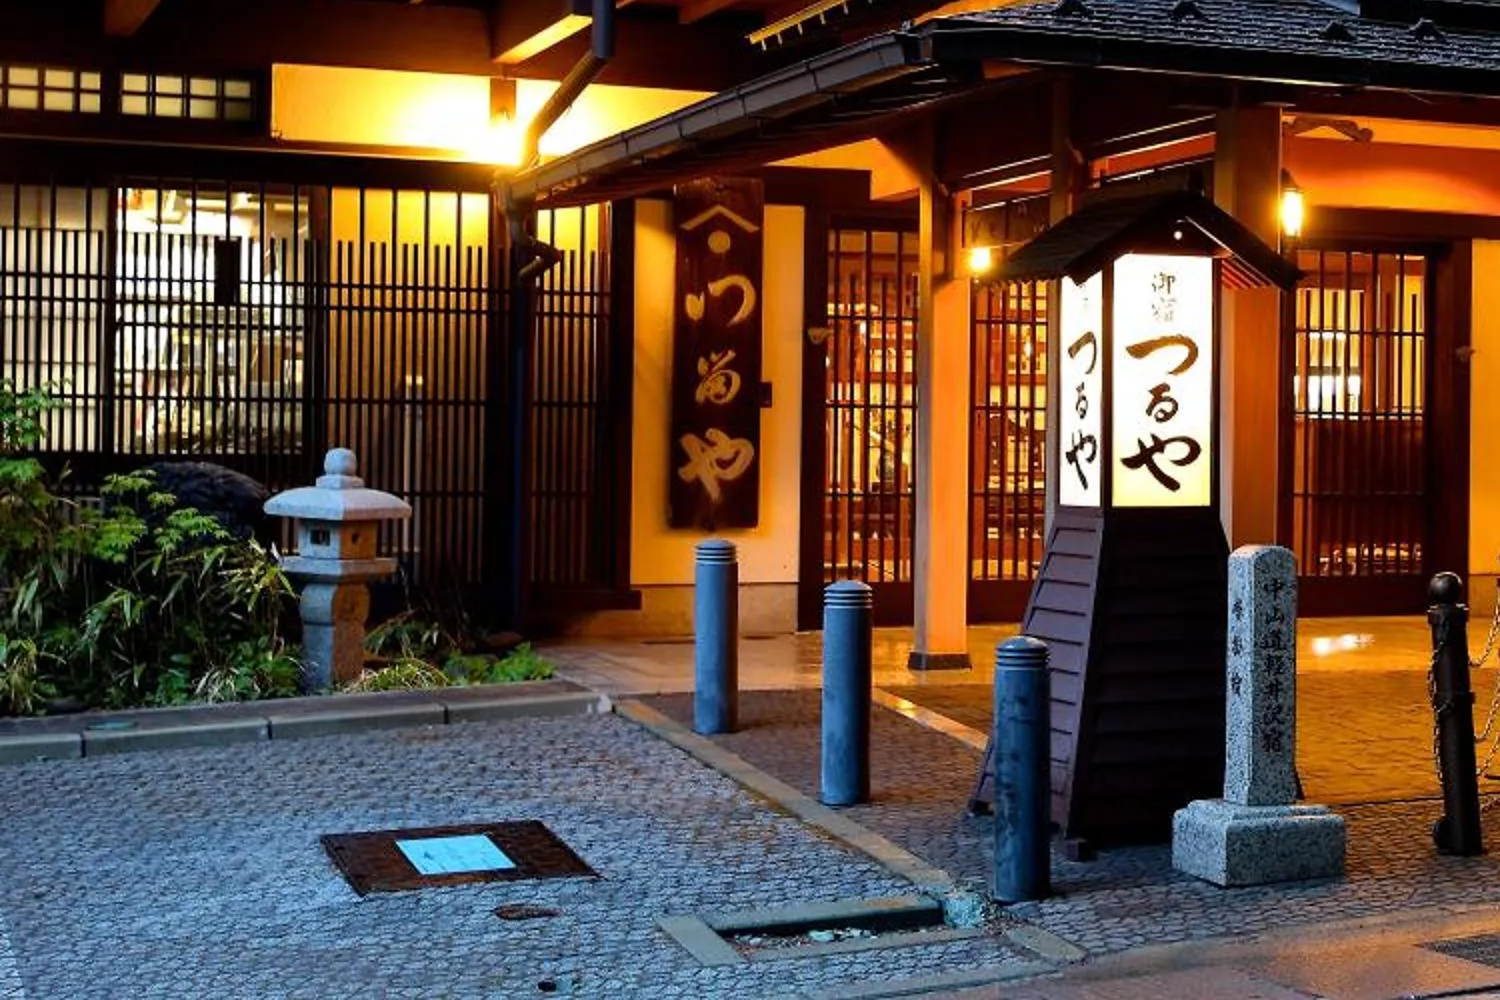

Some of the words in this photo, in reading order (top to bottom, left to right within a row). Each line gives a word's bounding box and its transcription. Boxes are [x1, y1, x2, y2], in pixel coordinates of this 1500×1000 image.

[1065, 331, 1098, 491] つるや
[1119, 333, 1203, 493] つるや
